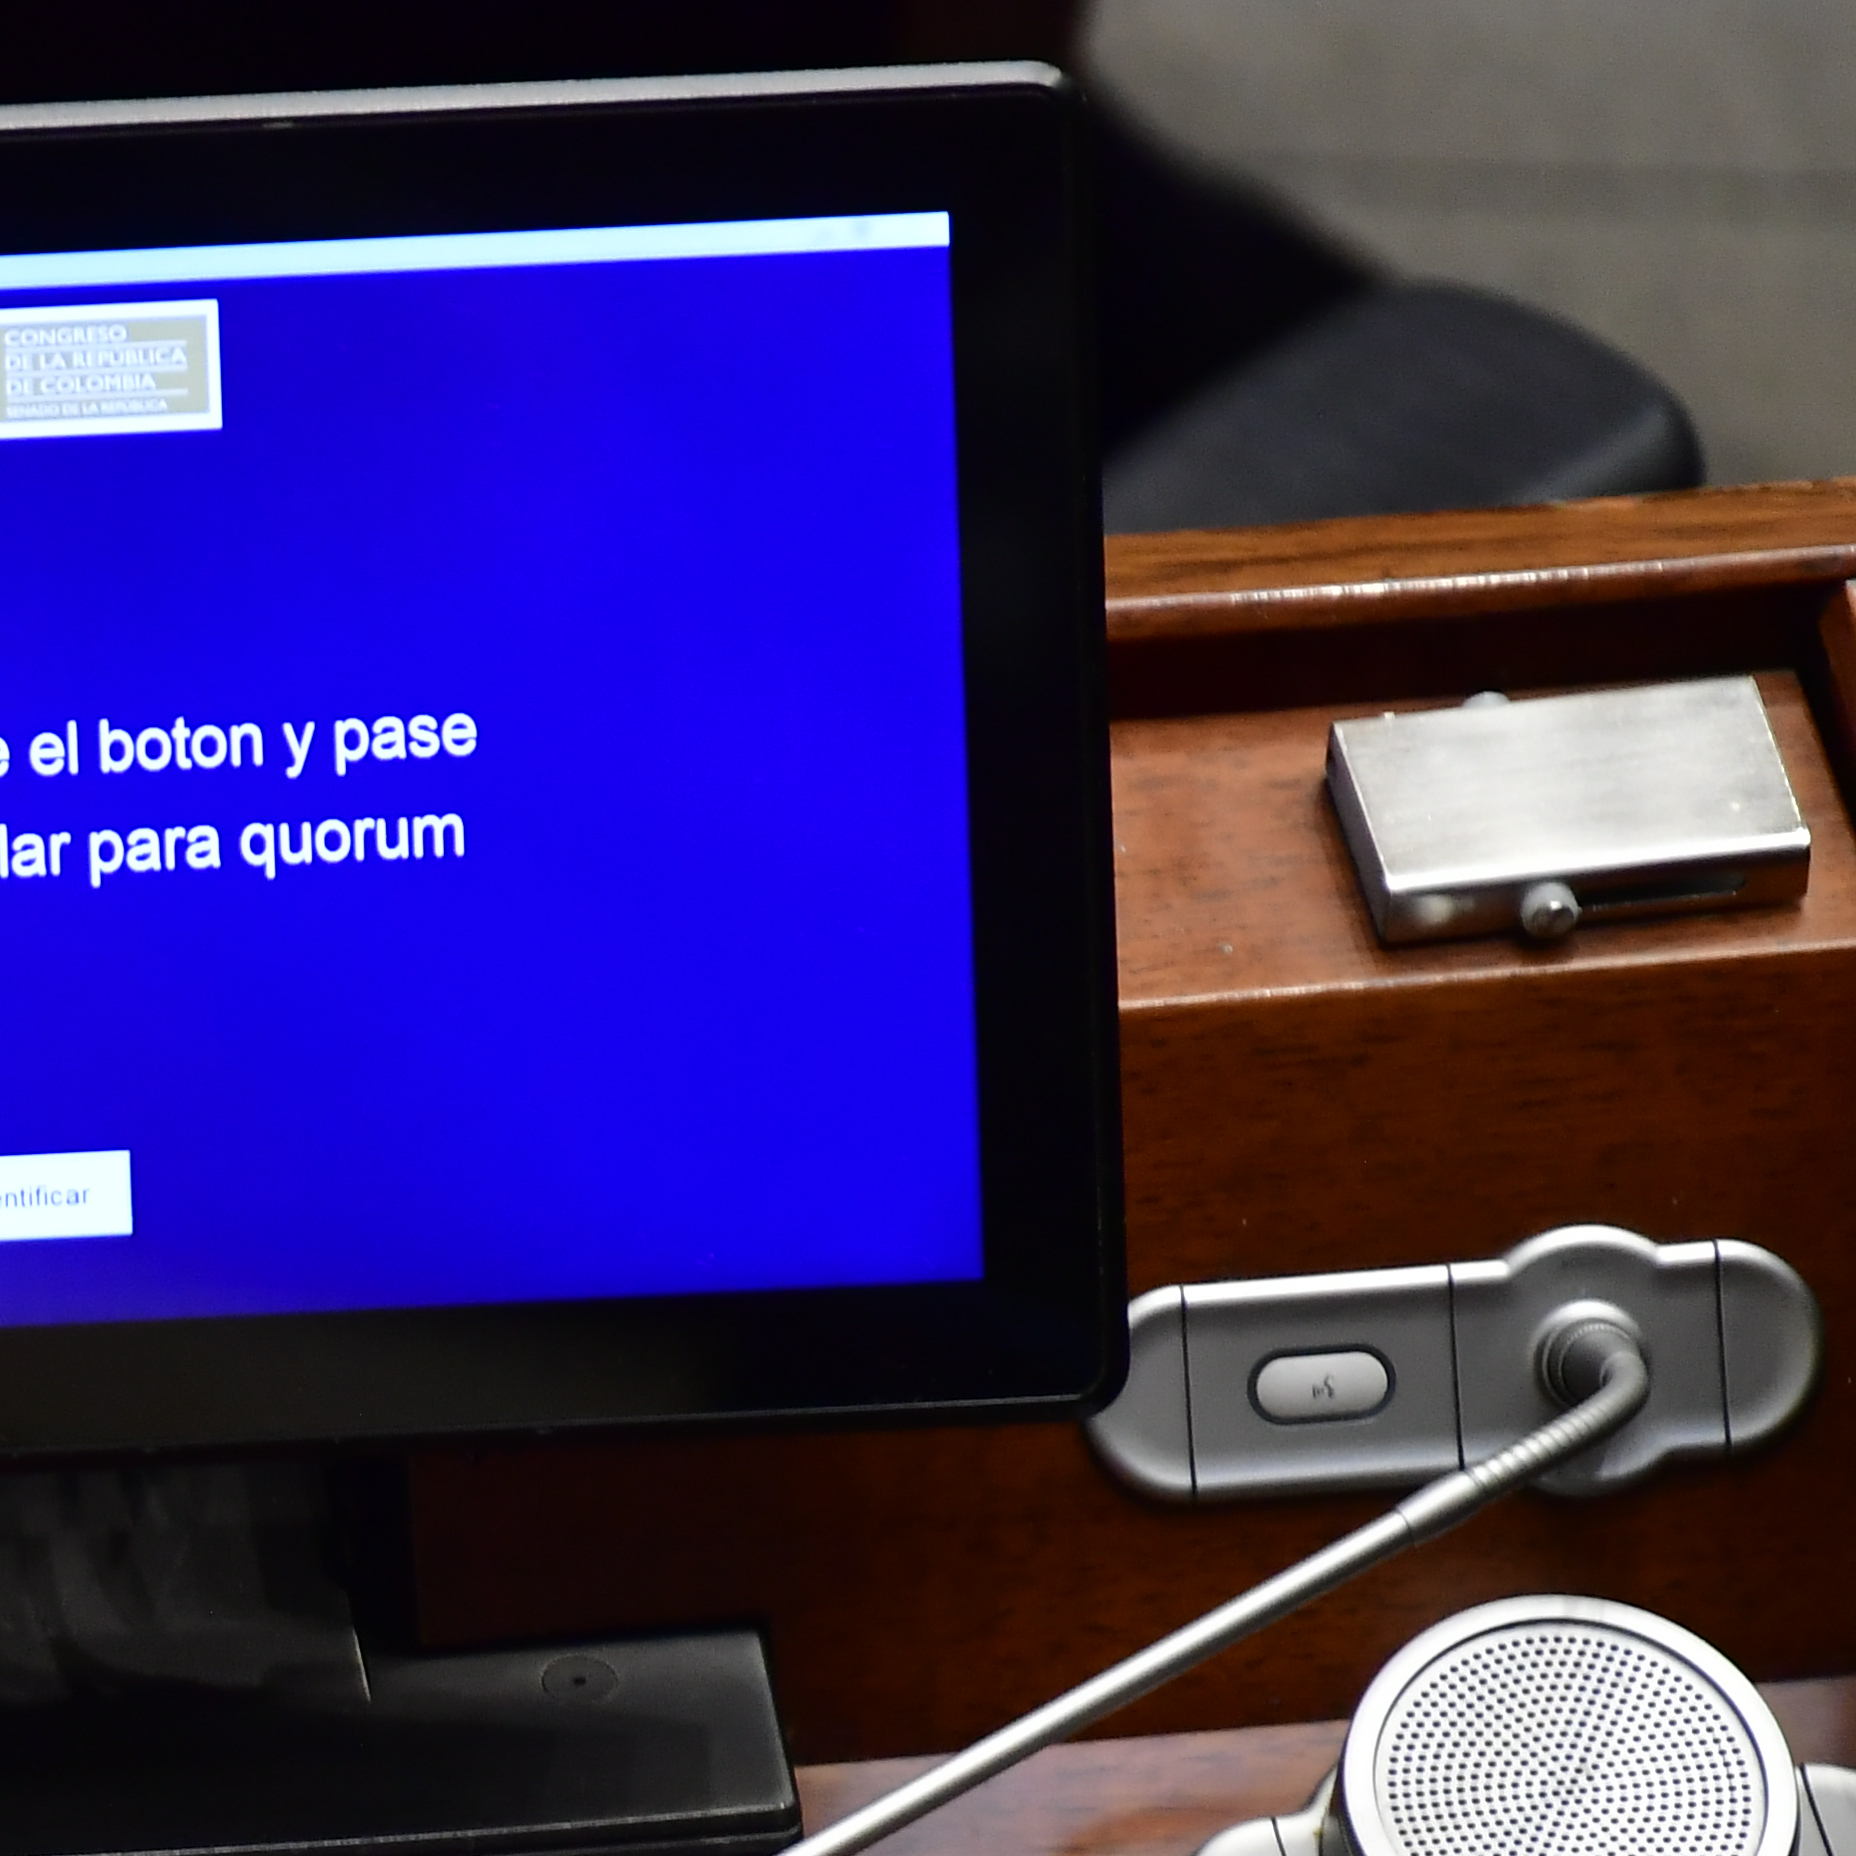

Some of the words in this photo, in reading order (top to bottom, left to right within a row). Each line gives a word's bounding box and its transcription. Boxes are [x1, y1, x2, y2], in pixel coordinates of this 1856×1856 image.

[4, 323, 129, 347] CONGRESO
[5, 353, 34, 372] DE
[39, 351, 67, 371] LA
[6, 376, 34, 396] DE
[40, 372, 157, 395] COLOMBIA
[82, 401, 100, 416] LA
[27, 720, 80, 778] el
[98, 716, 265, 776] boton
[281, 720, 316, 780] y
[331, 710, 478, 776] pase
[87, 819, 223, 888] para
[238, 811, 467, 880] quorum
